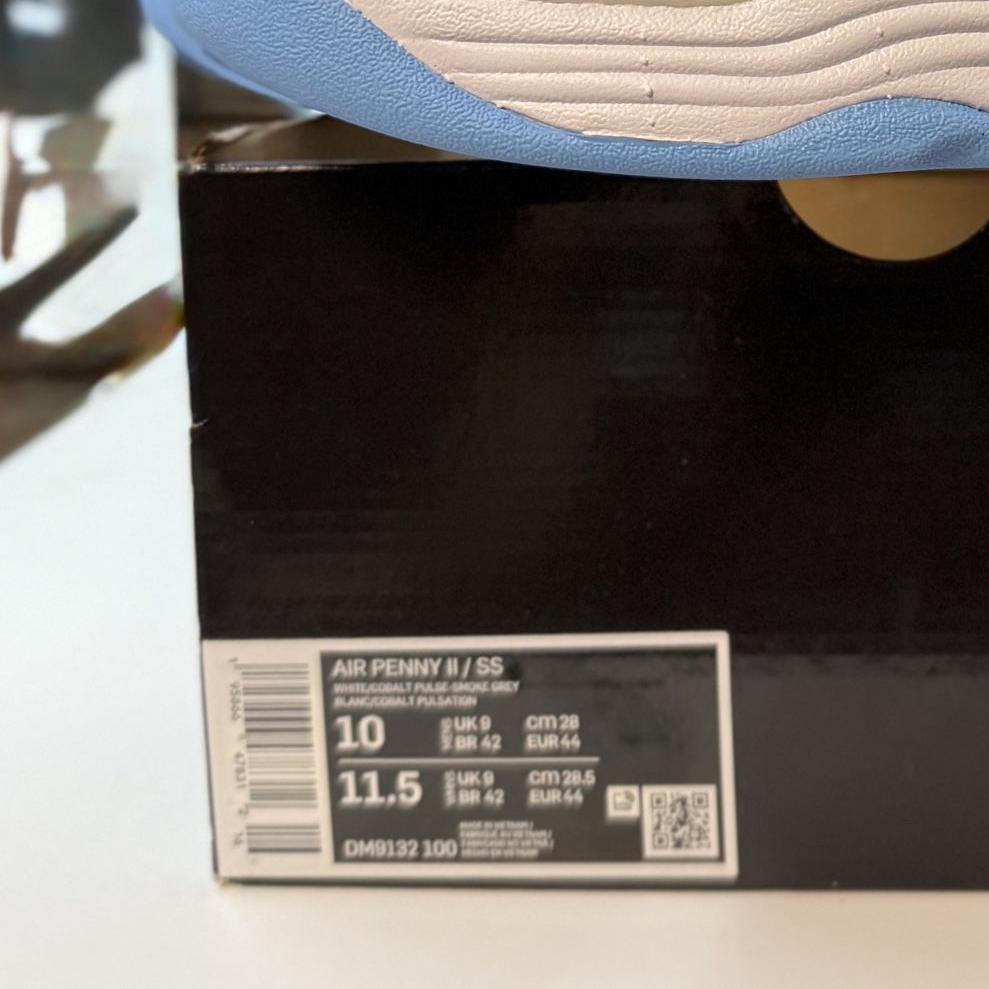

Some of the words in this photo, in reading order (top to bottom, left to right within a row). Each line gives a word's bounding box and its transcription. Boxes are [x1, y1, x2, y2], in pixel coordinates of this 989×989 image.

[332, 658, 367, 678] AIR
[371, 658, 442, 677] PENNY
[446, 657, 459, 676] II
[461, 657, 472, 680] /
[476, 656, 505, 676] SS
[490, 680, 520, 693] GREY
[416, 695, 478, 708] PULSATION
[454, 716, 478, 731] UK
[480, 715, 492, 731] 9
[559, 714, 580, 729] 28
[335, 714, 385, 749] 10
[455, 735, 478, 751] BR
[480, 734, 502, 751] 42
[526, 734, 559, 750] EUR
[560, 733, 581, 749] 44
[338, 770, 423, 804] 11.5
[457, 771, 481, 787] UK
[482, 770, 494, 787] 9
[562, 770, 596, 786] 28.5
[458, 790, 481, 805] BR
[483, 789, 505, 805] 42
[529, 790, 562, 805] EUR
[562, 789, 584, 804] 44
[344, 839, 419, 858] DM9132
[422, 840, 458, 858] 100
